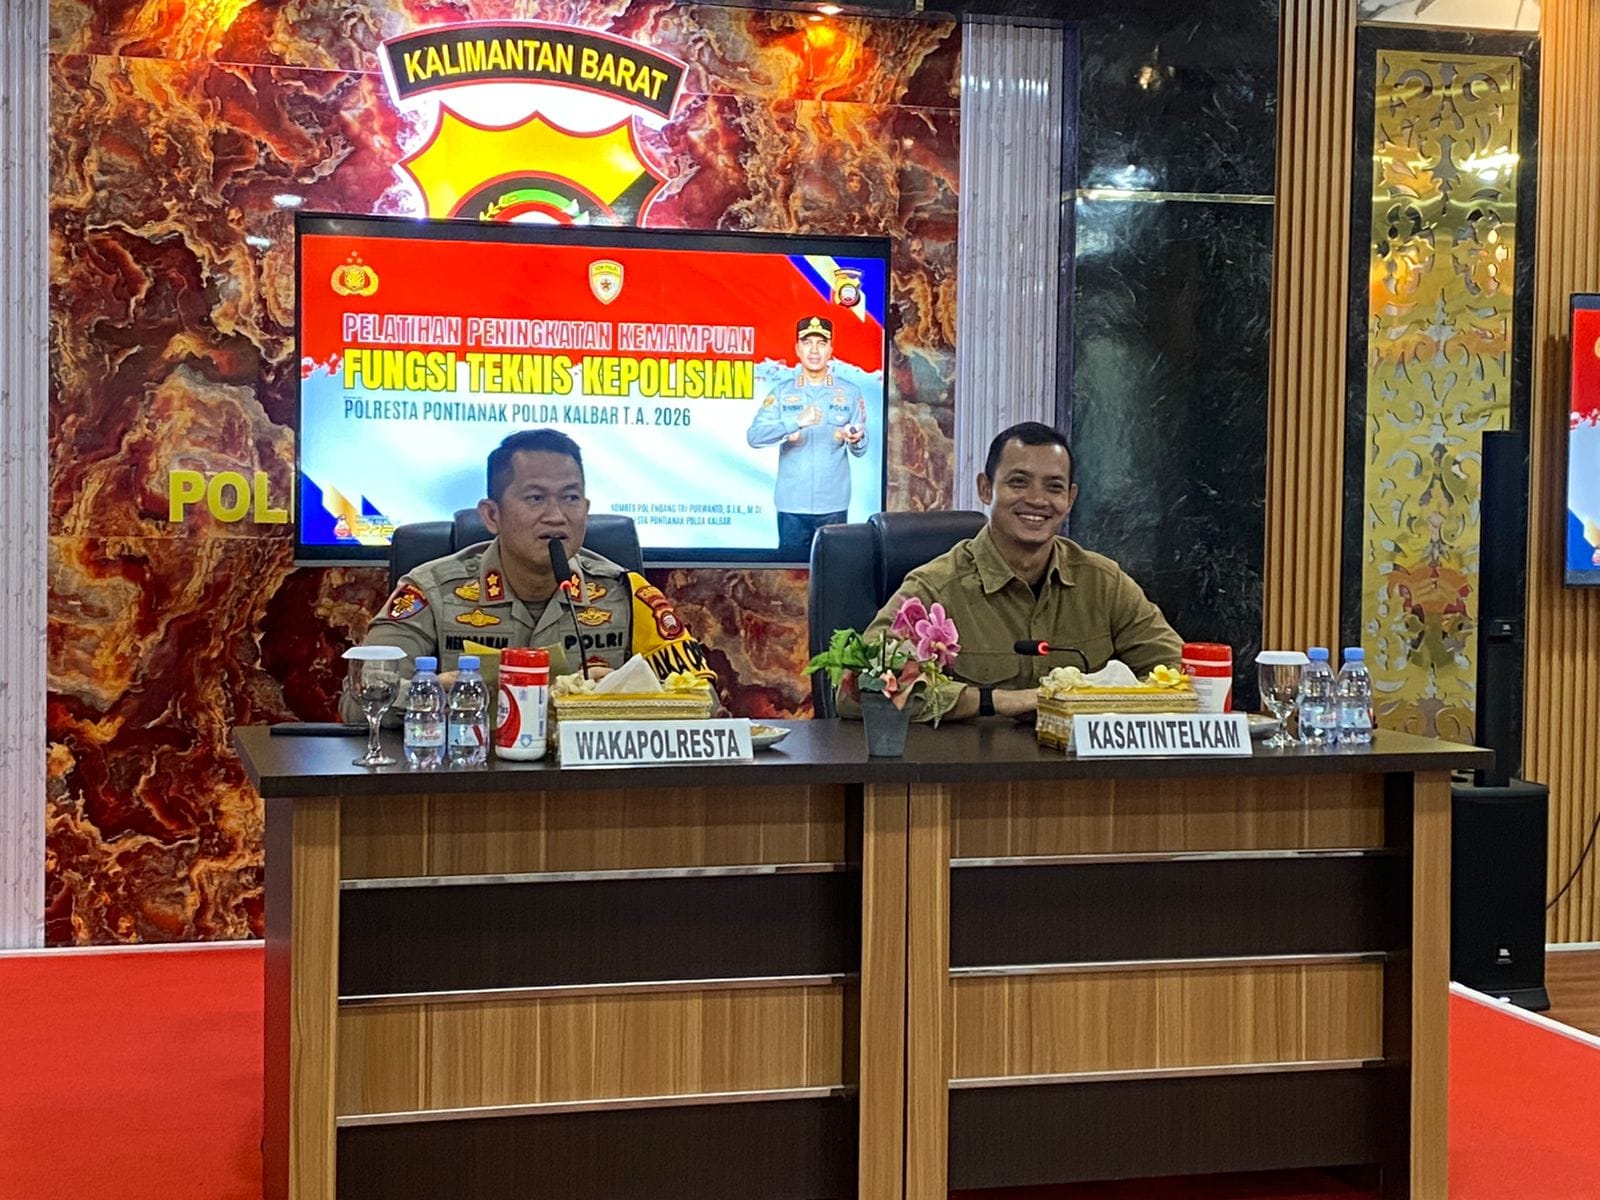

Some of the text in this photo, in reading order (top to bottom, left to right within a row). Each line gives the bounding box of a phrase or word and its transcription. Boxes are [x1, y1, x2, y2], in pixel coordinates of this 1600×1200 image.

[404, 39, 668, 101] KALIMANTAN BARAT
[343, 313, 755, 354] PELATIHAN PENINGKATAN KEMAMPUAN
[343, 348, 754, 399] FUNGSI TEKNIS KEPOLISIAN
[345, 400, 691, 426] POLRESTA PONTIANAK POLDA KALBAR T.A. 2026
[169, 470, 295, 524] POL
[564, 631, 623, 650] POLRI
[576, 729, 740, 760] WAKAPOLRESTA
[1088, 720, 1241, 749] KASATINTELKAM
